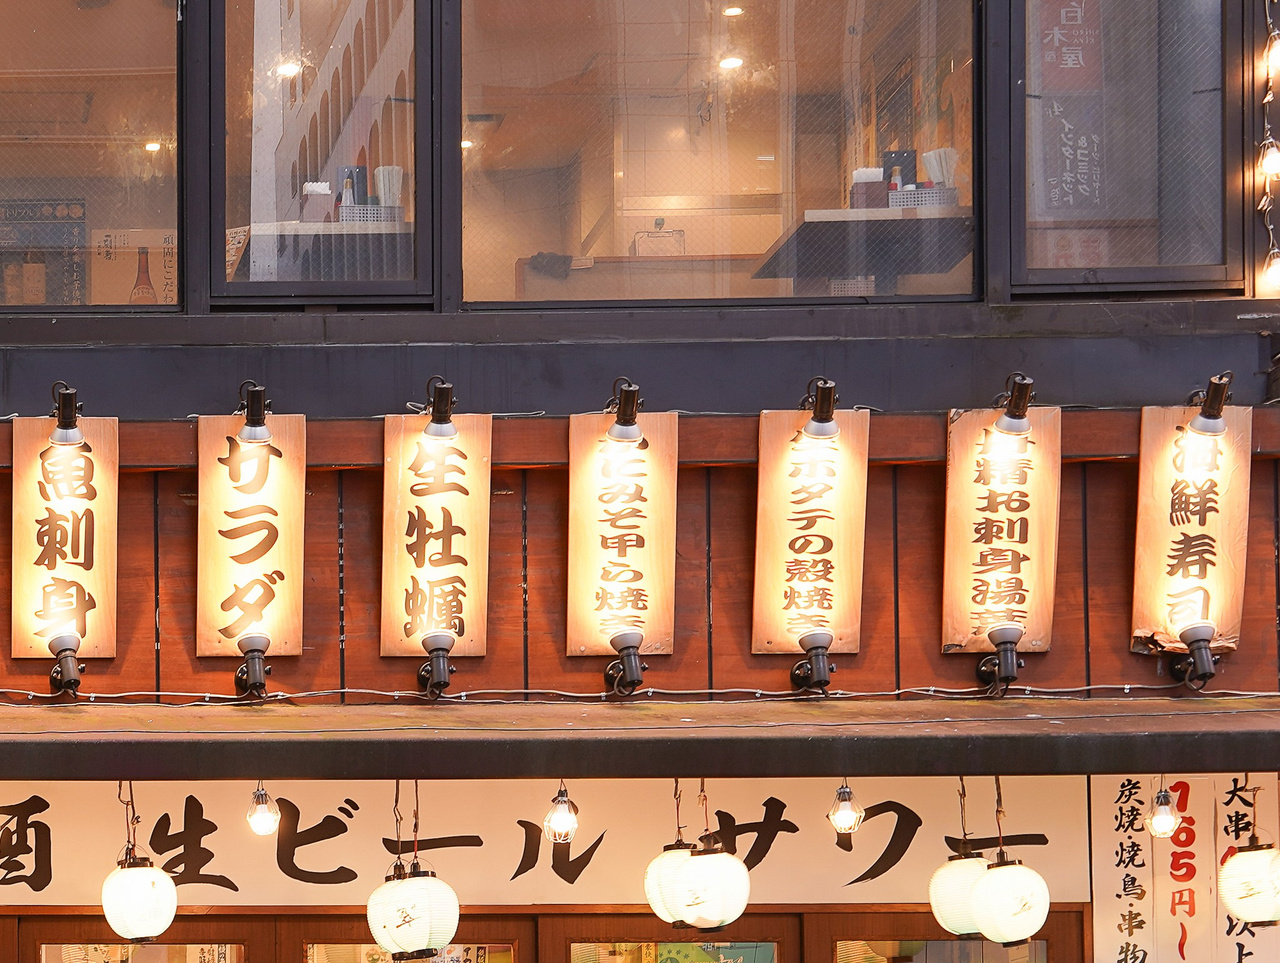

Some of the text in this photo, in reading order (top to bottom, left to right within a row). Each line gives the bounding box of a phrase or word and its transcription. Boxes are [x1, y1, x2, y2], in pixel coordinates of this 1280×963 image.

[217, 435, 285, 640] サラダ
[403, 441, 470, 639] 生牡蠣
